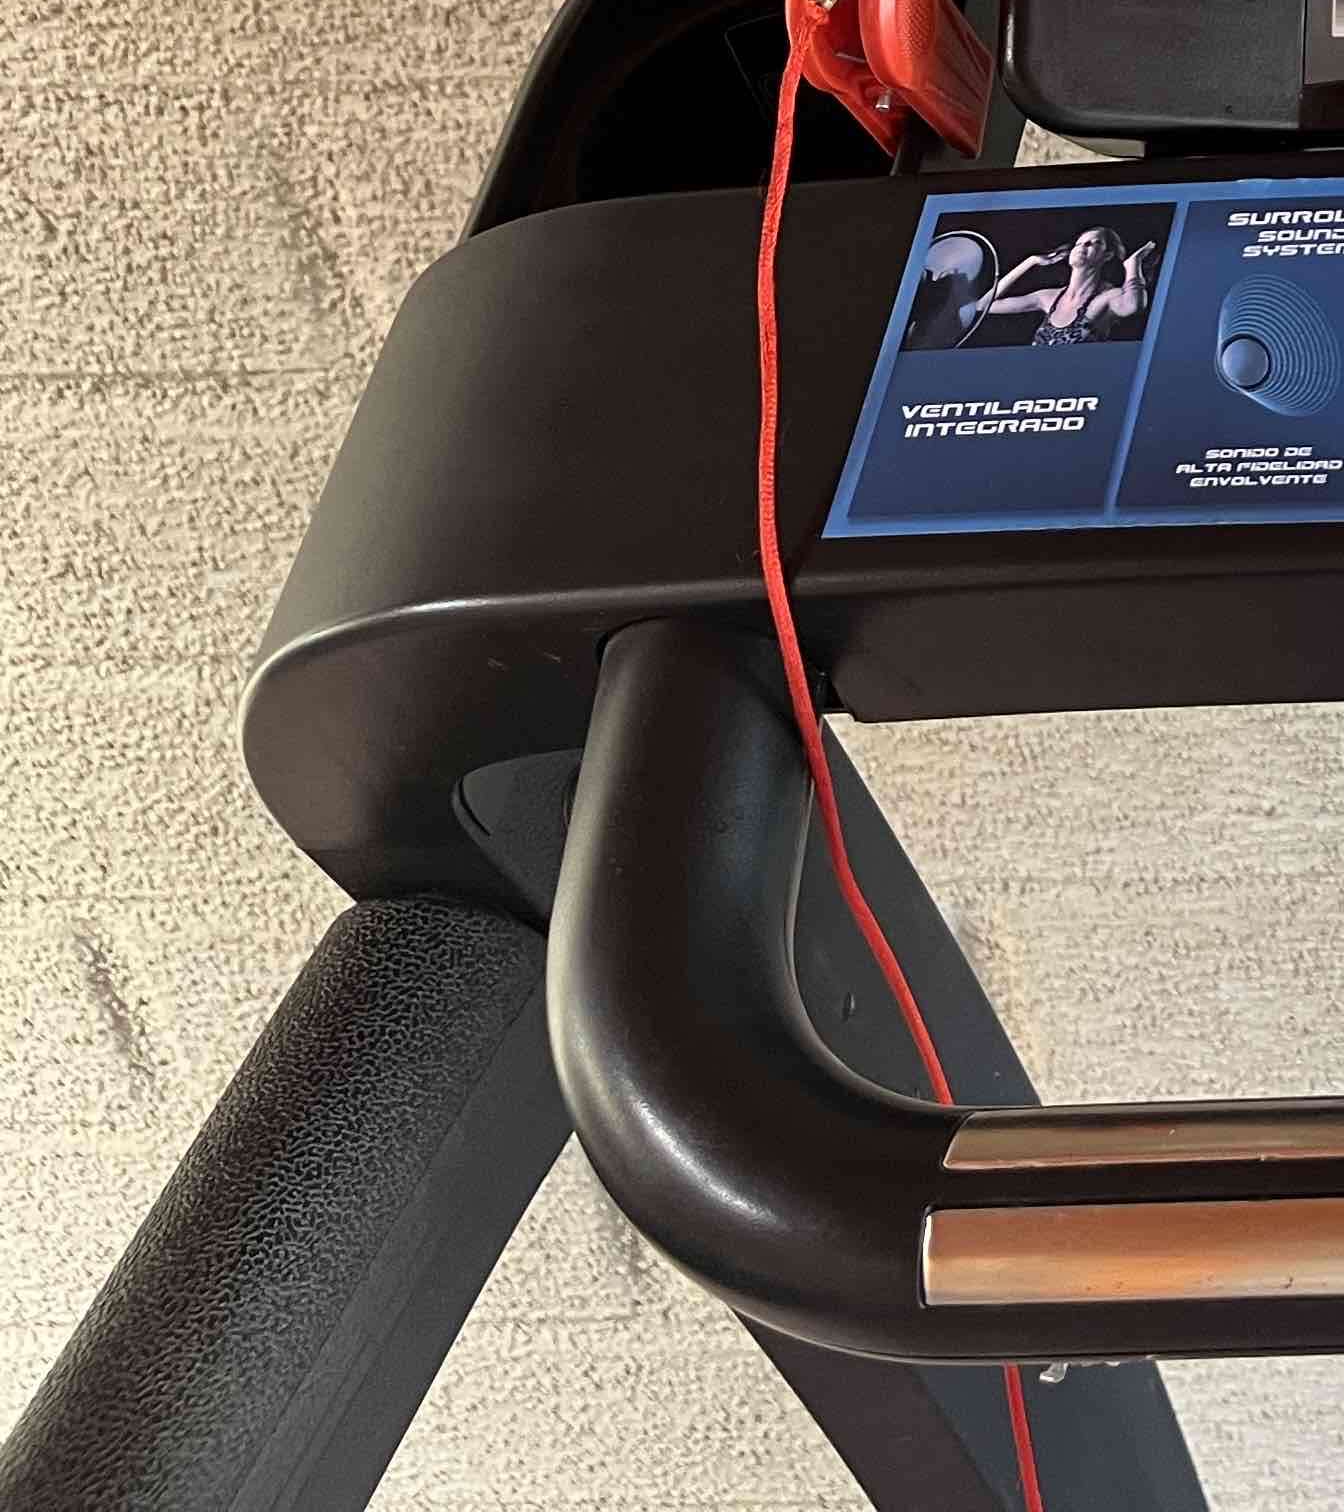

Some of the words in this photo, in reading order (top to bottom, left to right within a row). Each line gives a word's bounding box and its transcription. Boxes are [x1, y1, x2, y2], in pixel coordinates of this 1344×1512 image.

[901, 397, 1099, 419] VENTILADOR
[905, 416, 1085, 438] INTEGRADO
[1205, 447, 1279, 459] SONIDO
[1284, 446, 1313, 457] DE
[1176, 463, 1232, 474] ALTA
[1236, 460, 1344, 472] FIDELIDAD
[1190, 474, 1328, 488] ENVOLVENTE
